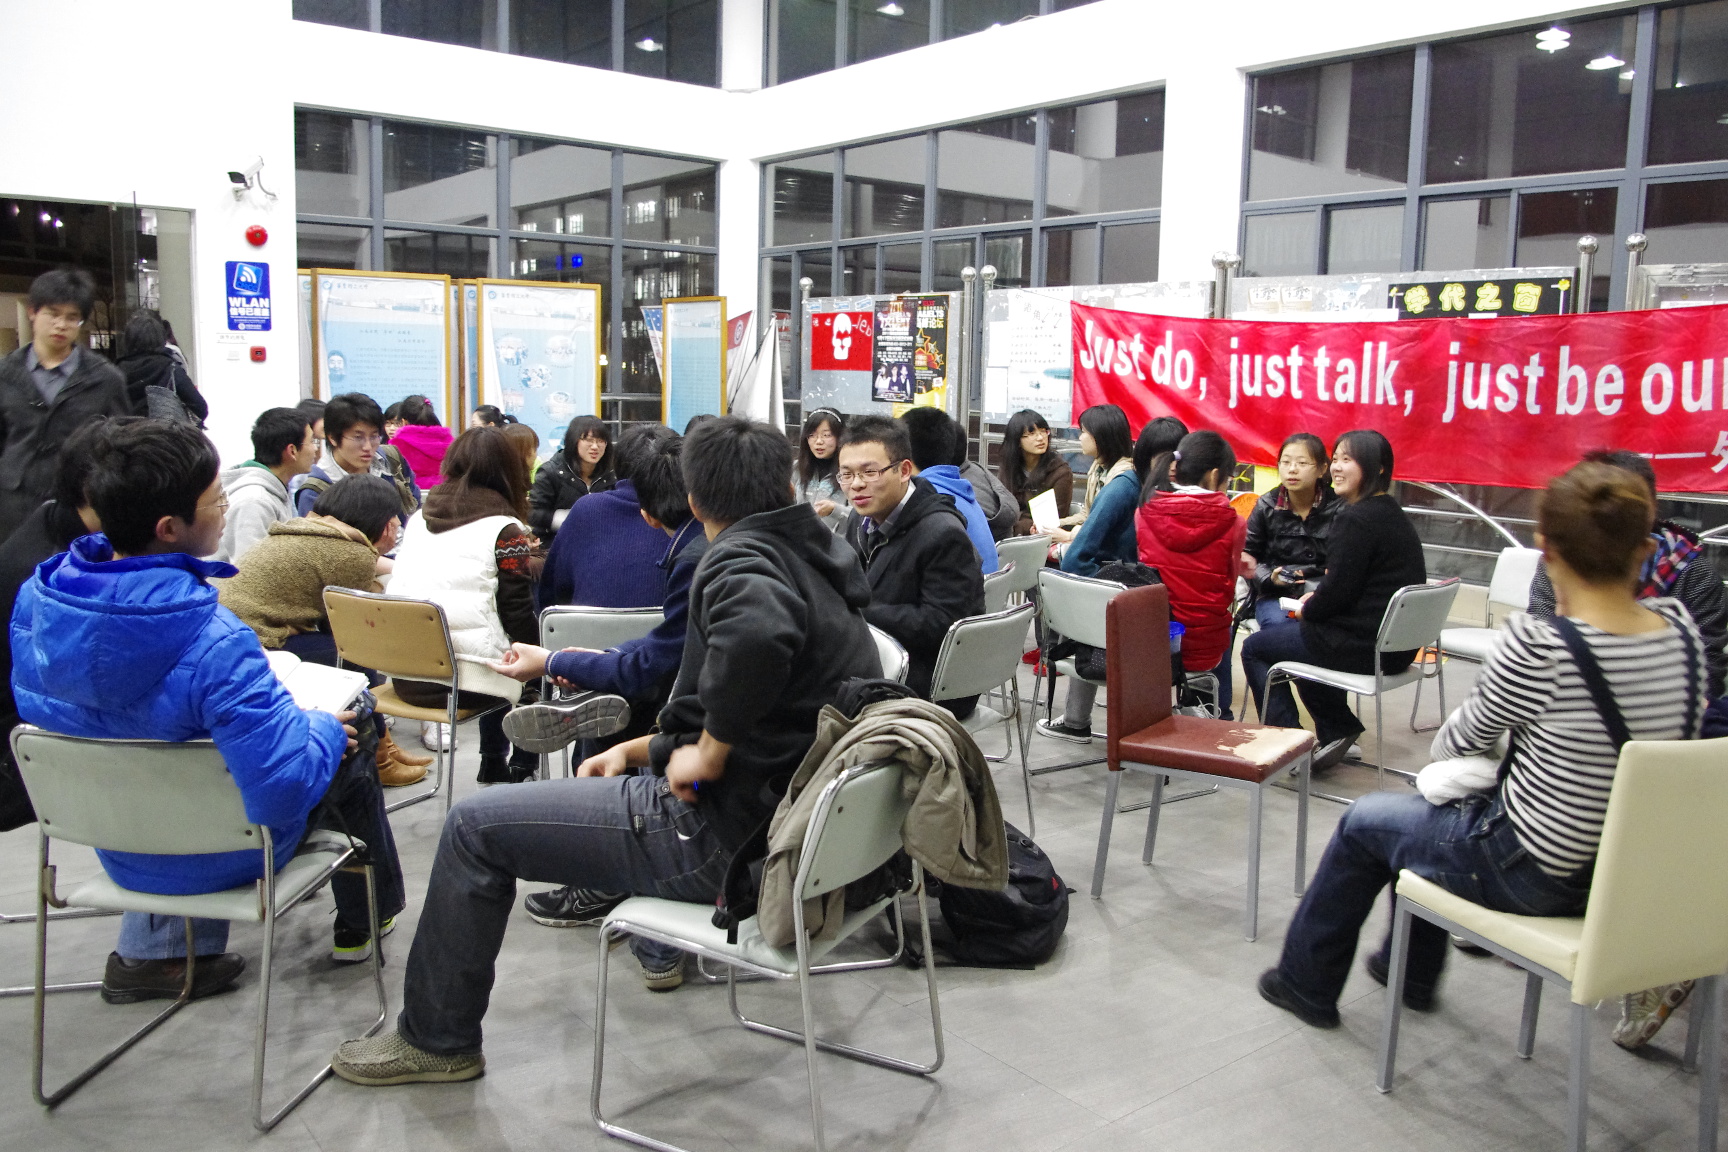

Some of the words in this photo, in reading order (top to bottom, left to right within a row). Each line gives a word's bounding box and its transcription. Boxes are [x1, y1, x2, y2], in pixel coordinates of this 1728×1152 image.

[228, 296, 270, 308] WLAN
[1404, 282, 1542, 314] 学代之窗
[1080, 319, 1146, 380] Just
[1151, 330, 1207, 400] do,
[1228, 336, 1303, 409] just
[1313, 341, 1414, 416] talk,
[1442, 341, 1544, 423] just
[1556, 345, 1624, 416] be
[1641, 356, 1728, 415] ou
